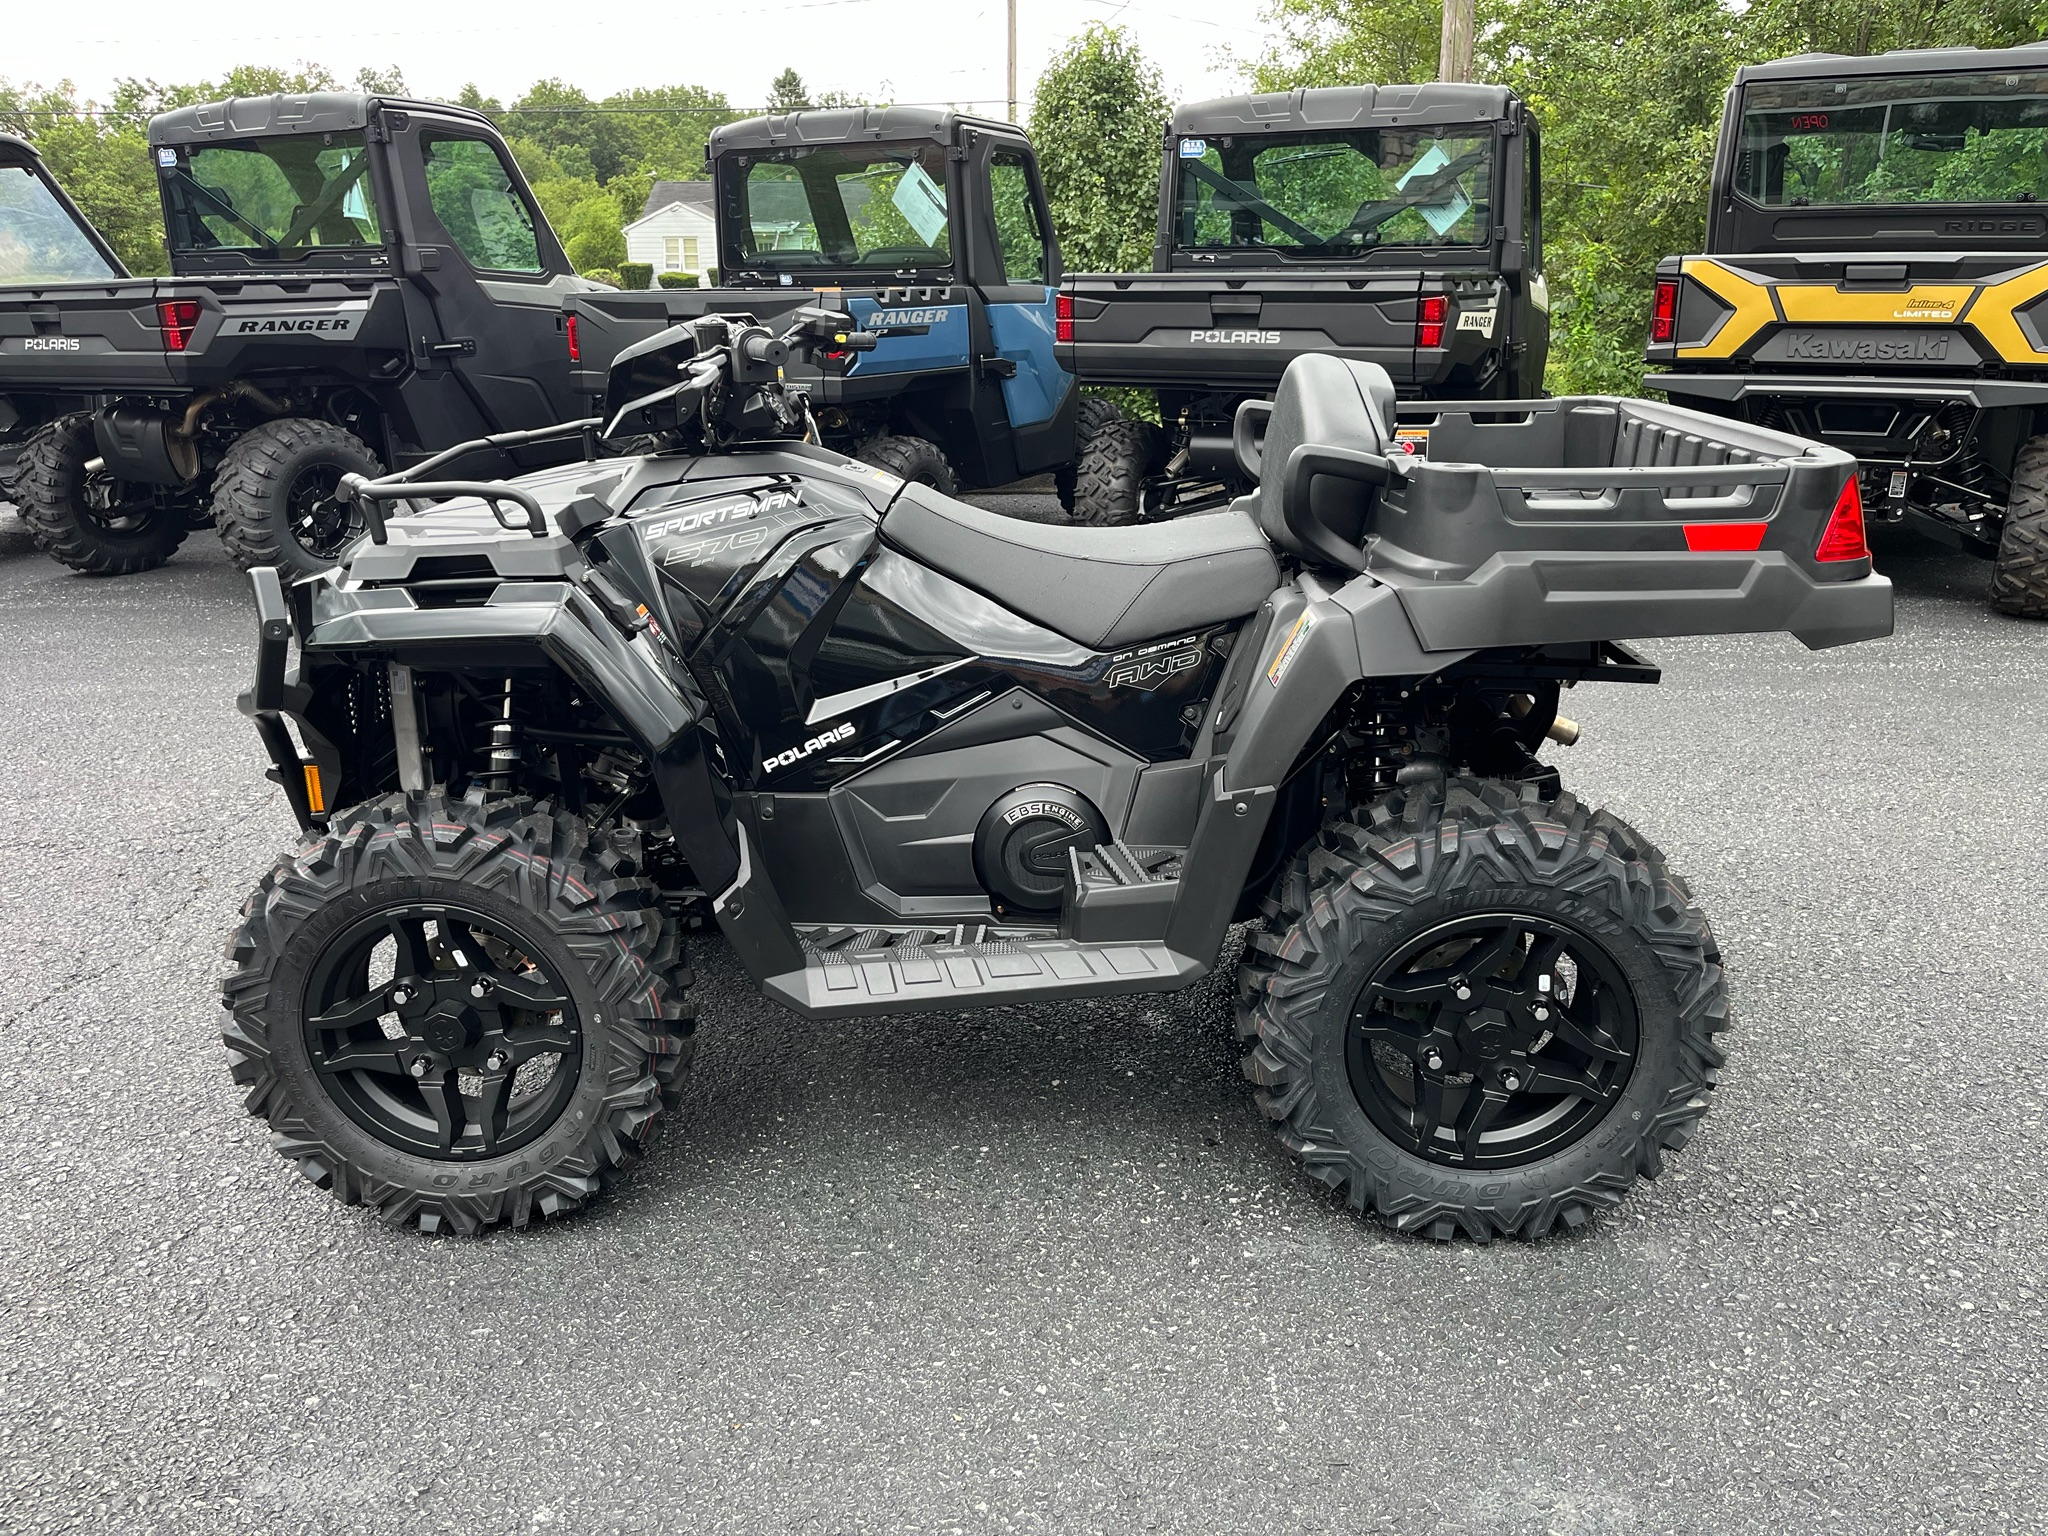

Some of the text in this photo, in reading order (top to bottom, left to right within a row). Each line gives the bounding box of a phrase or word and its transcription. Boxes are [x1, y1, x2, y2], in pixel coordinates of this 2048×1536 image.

[1944, 220, 2037, 232] RIDGE
[868, 309, 949, 326] RANGER
[1463, 315, 1492, 328] RANGER
[1893, 310, 1953, 319] LIMITED
[238, 319, 350, 333] RANGER
[24, 338, 80, 351] POLARIS
[1190, 330, 1281, 344] POLARIS
[1786, 333, 1950, 361] Kawasaki
[644, 490, 803, 541] SPORTSMAN
[664, 526, 768, 567] 570
[1109, 650, 1202, 689] AWD
[1008, 804, 1041, 822] EBS
[1044, 804, 1083, 826] ENGINE
[432, 1141, 558, 1189] DURO
[1367, 1147, 1511, 1201] DURO
